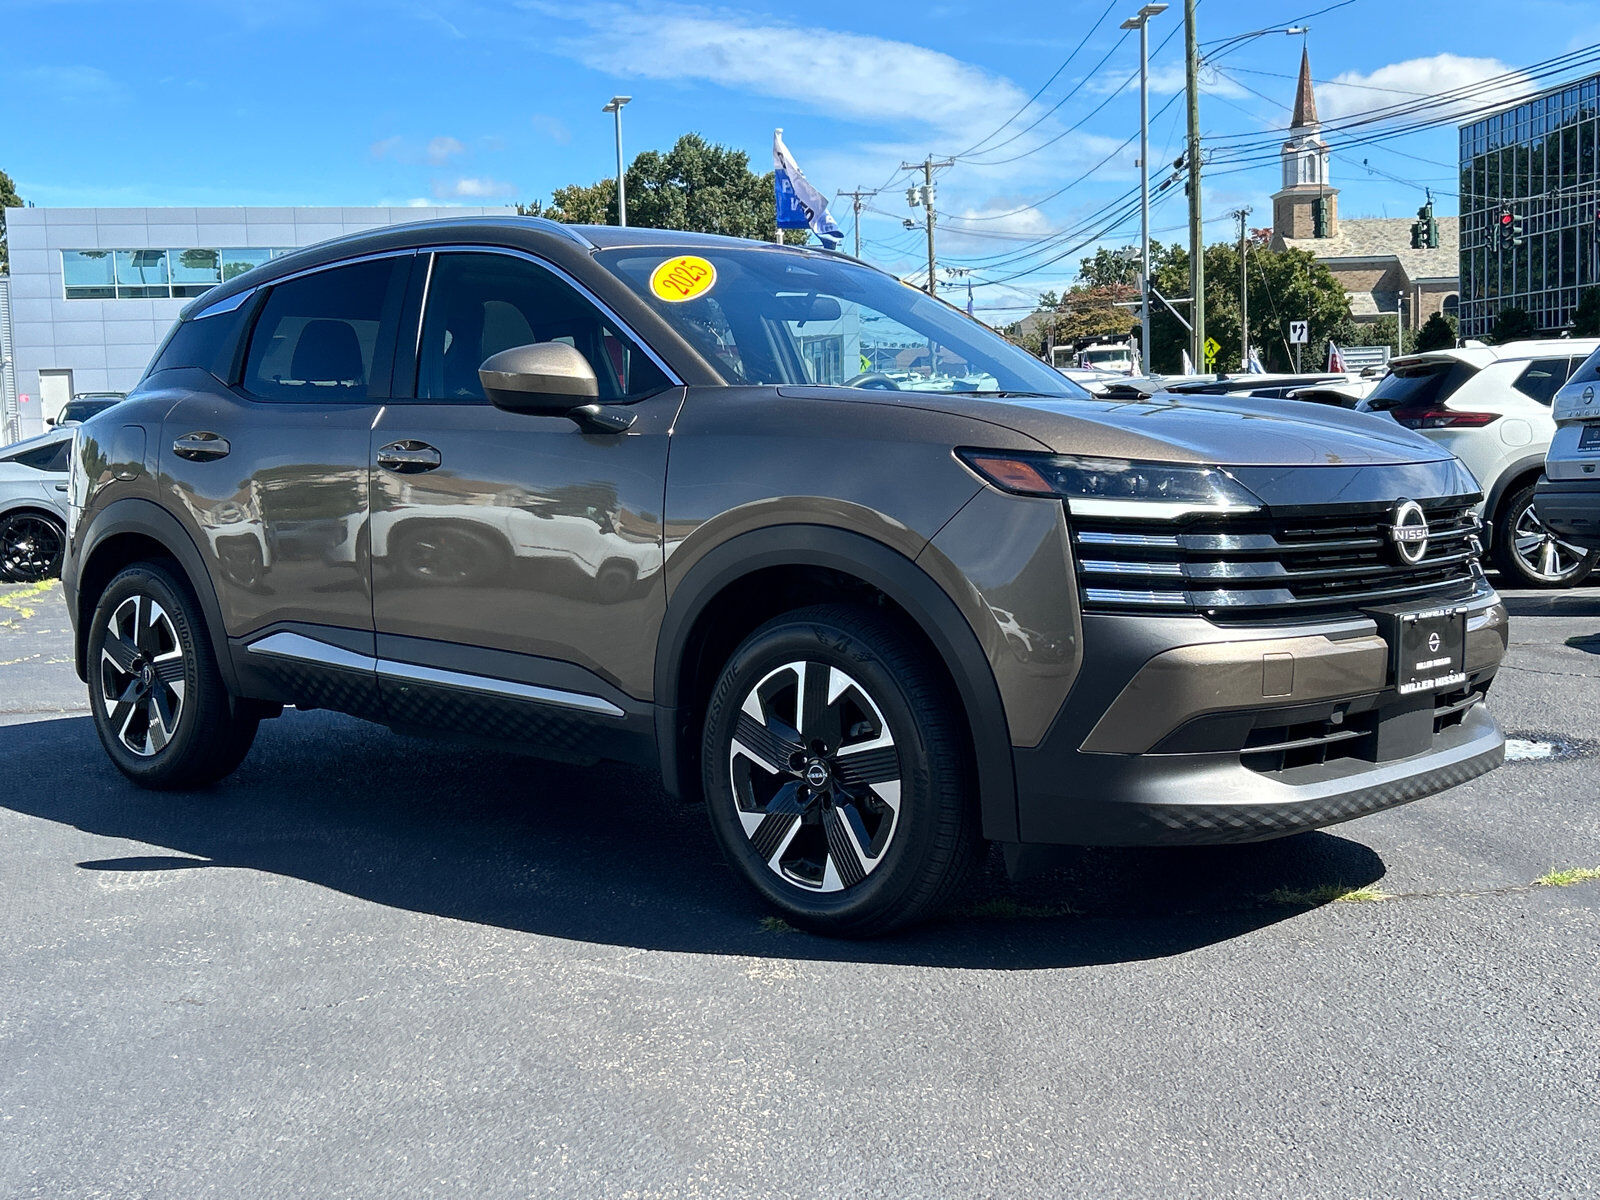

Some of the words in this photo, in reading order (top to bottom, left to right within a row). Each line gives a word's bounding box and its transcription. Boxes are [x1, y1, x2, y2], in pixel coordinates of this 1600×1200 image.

[663, 260, 707, 295] 2025
[1400, 679, 1435, 695] MILLER
[1434, 672, 1466, 688] NISSAN
